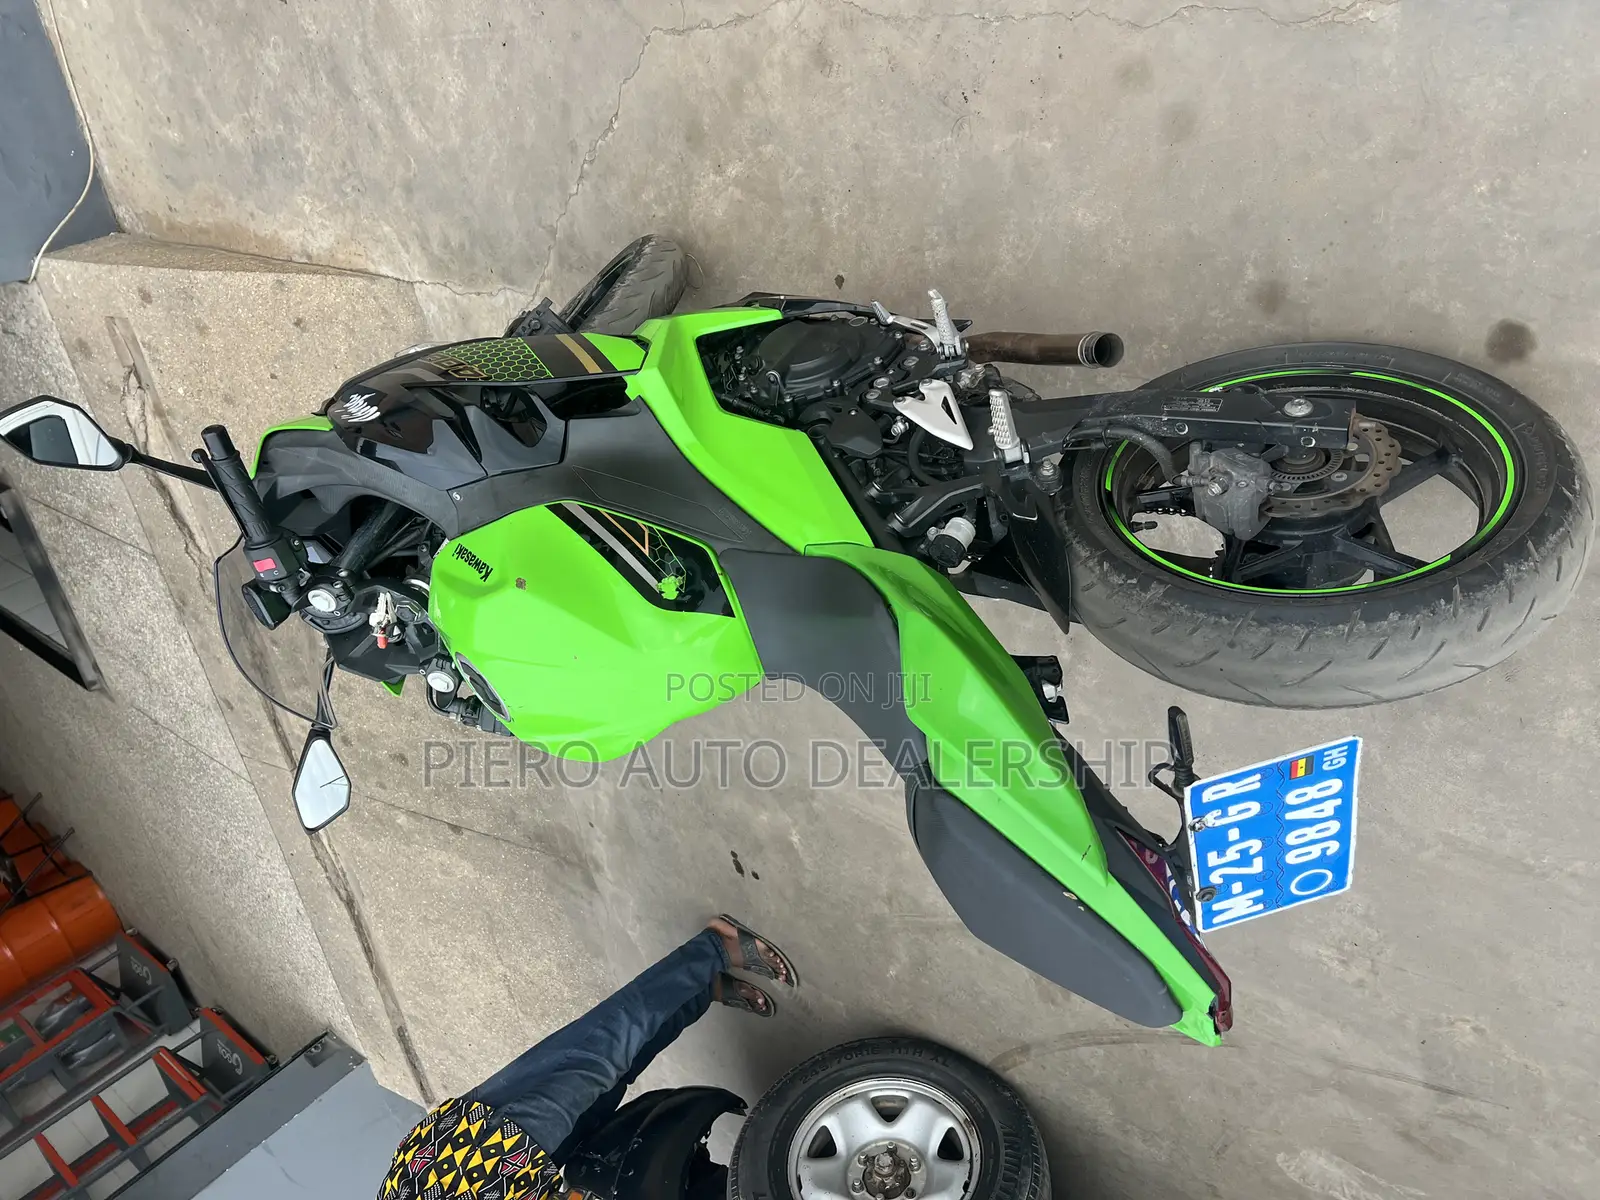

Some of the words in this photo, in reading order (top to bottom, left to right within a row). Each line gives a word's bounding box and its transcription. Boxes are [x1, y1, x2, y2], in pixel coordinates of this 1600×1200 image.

[452, 543, 494, 582] Kawasaki
[1322, 745, 1348, 771] GH
[1285, 778, 1343, 864] 9848
